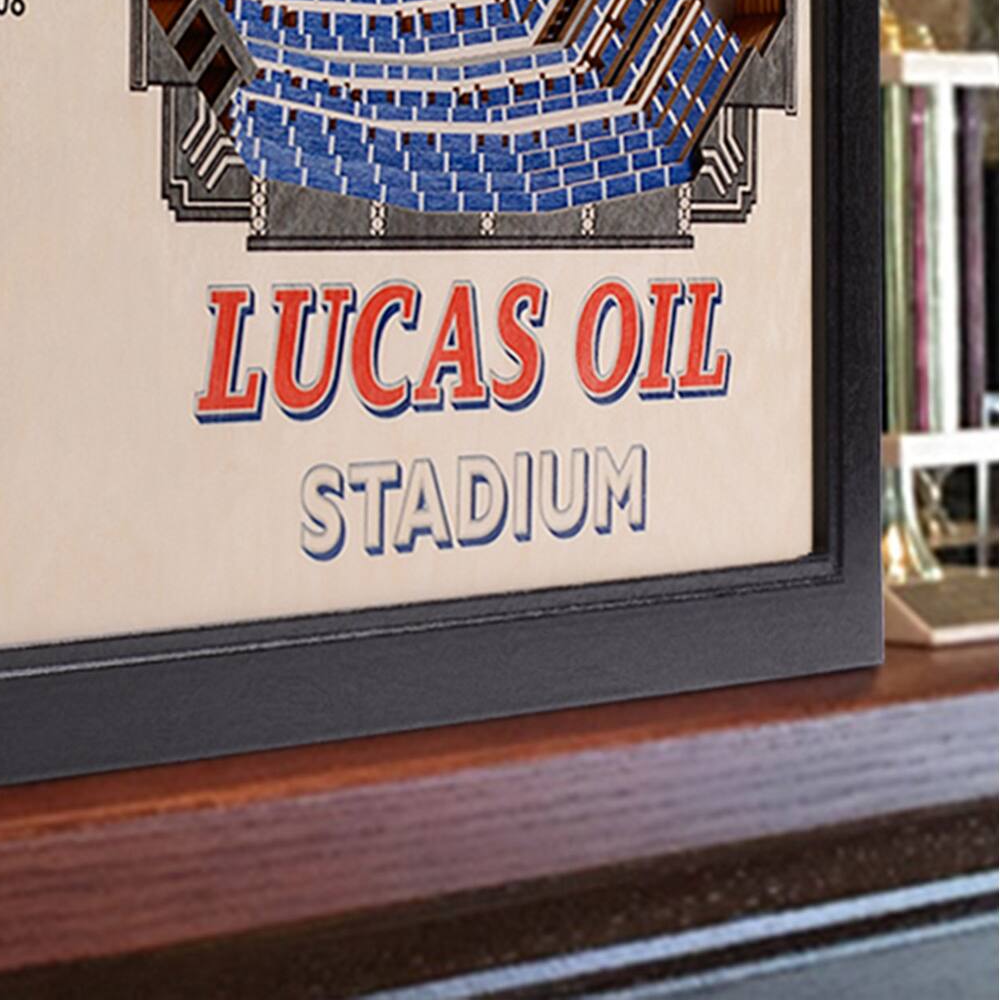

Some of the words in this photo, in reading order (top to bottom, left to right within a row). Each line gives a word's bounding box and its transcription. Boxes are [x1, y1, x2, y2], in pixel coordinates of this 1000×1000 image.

[194, 278, 549, 424] LUCAS
[575, 276, 731, 405] OIL
[301, 444, 646, 561] STADIUM
